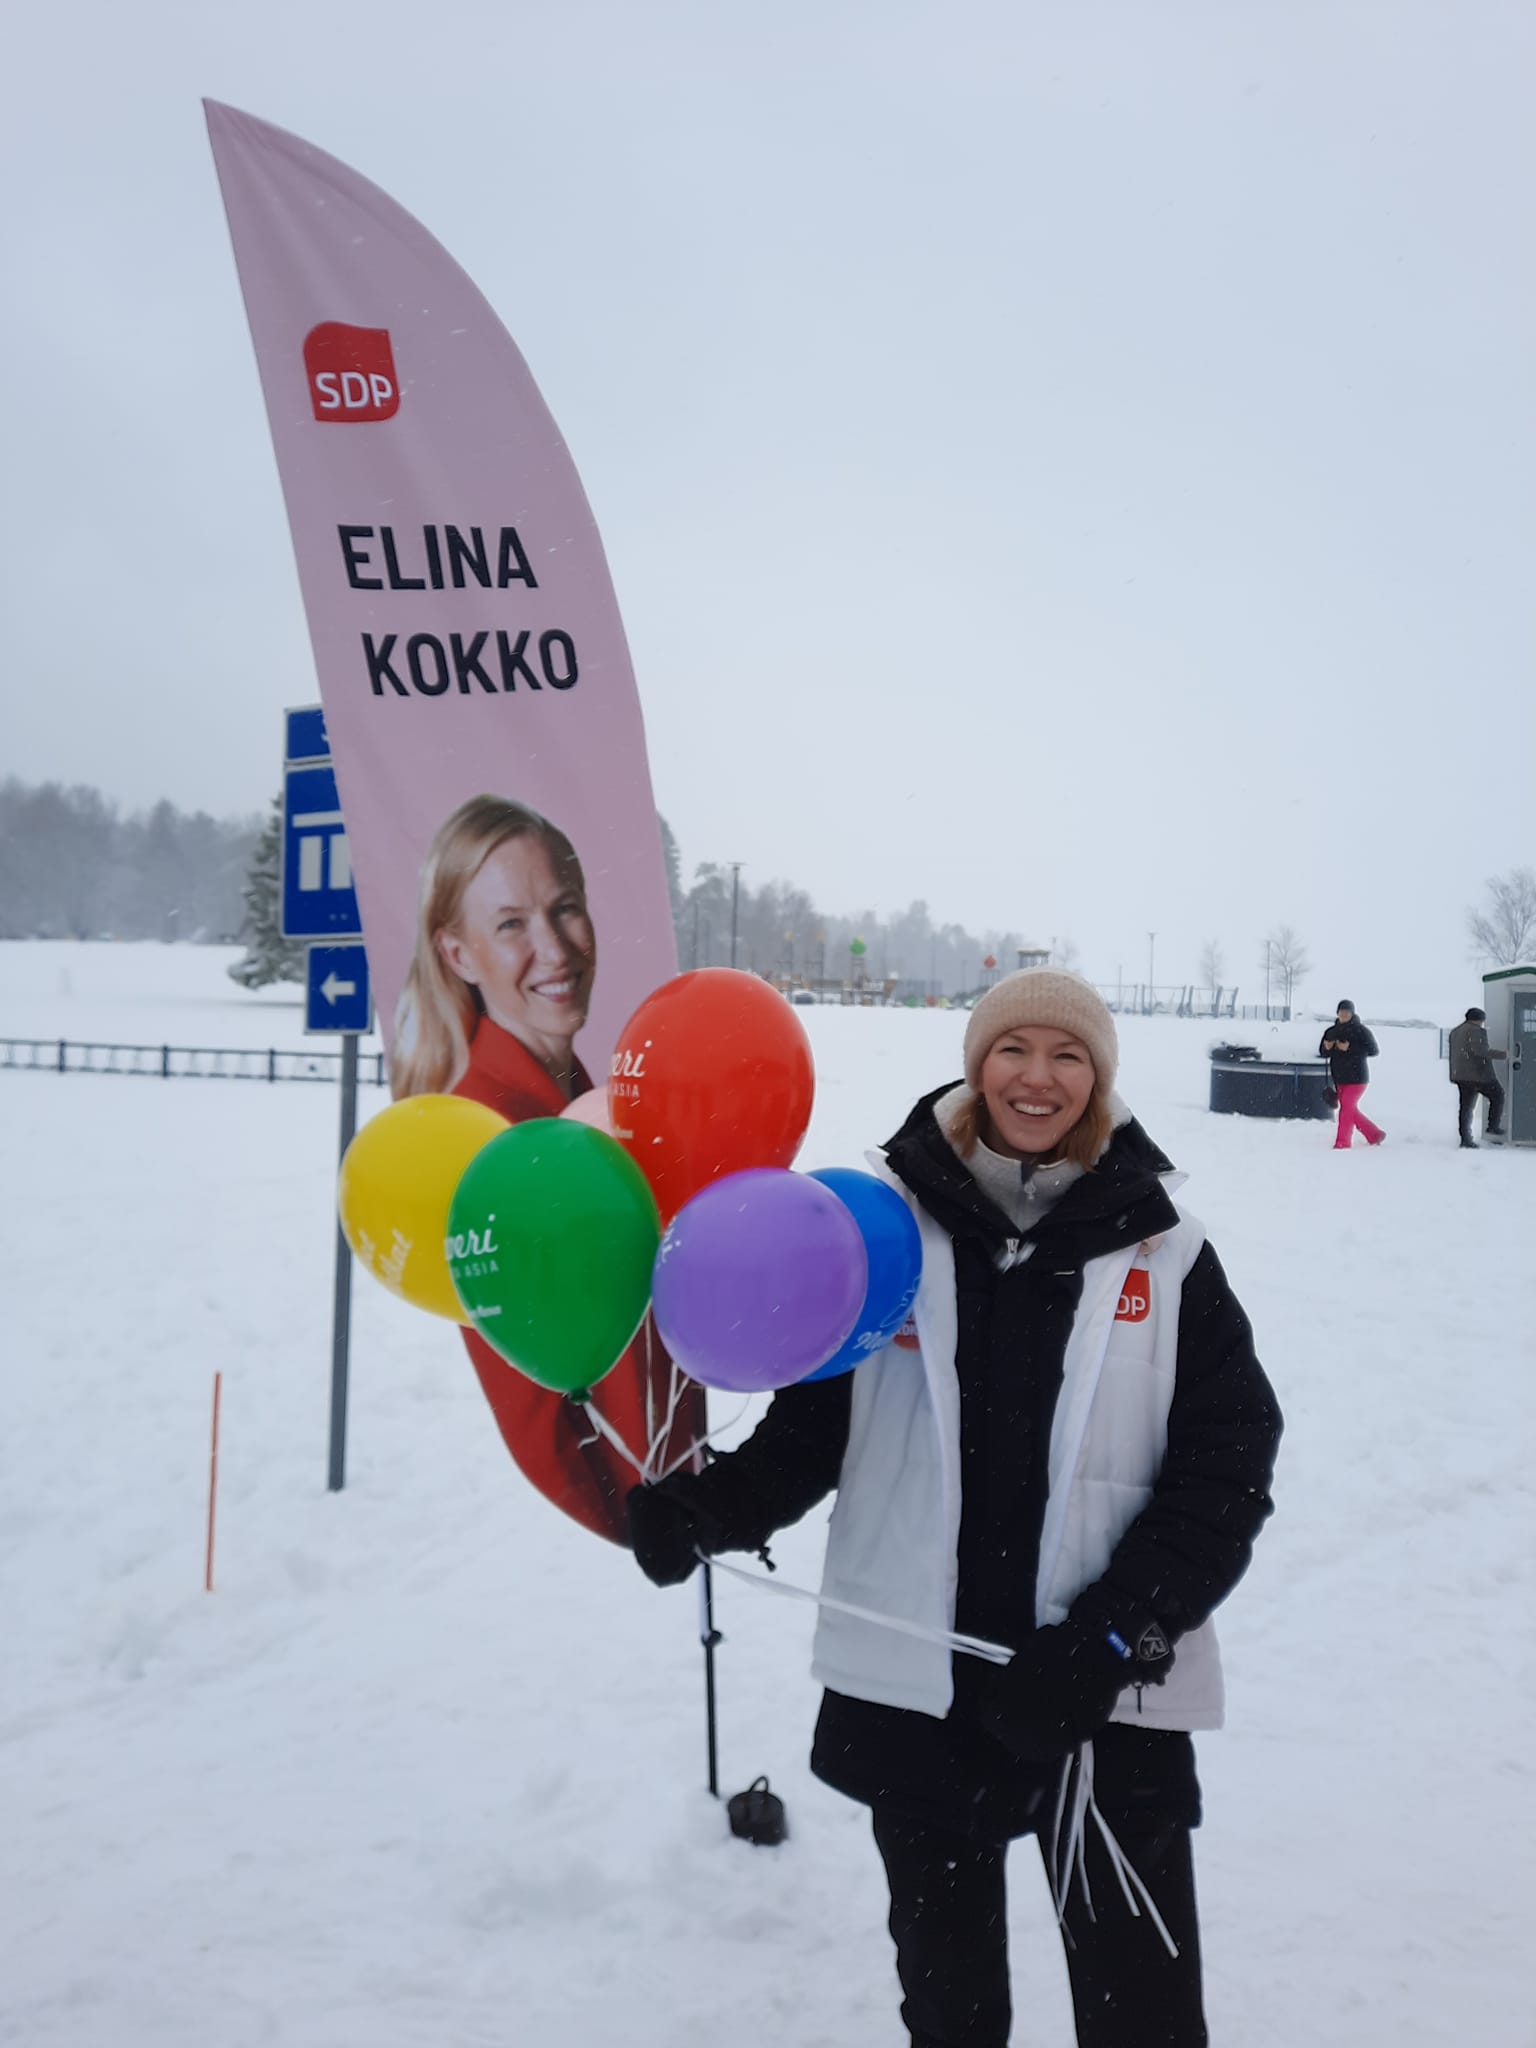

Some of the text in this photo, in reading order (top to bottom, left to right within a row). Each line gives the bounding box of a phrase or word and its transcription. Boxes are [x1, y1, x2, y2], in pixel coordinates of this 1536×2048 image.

[315, 371, 393, 408] SDP
[337, 524, 539, 590] ELINA
[361, 628, 579, 697] KOKKO
[1116, 1294, 1147, 1316] DP
